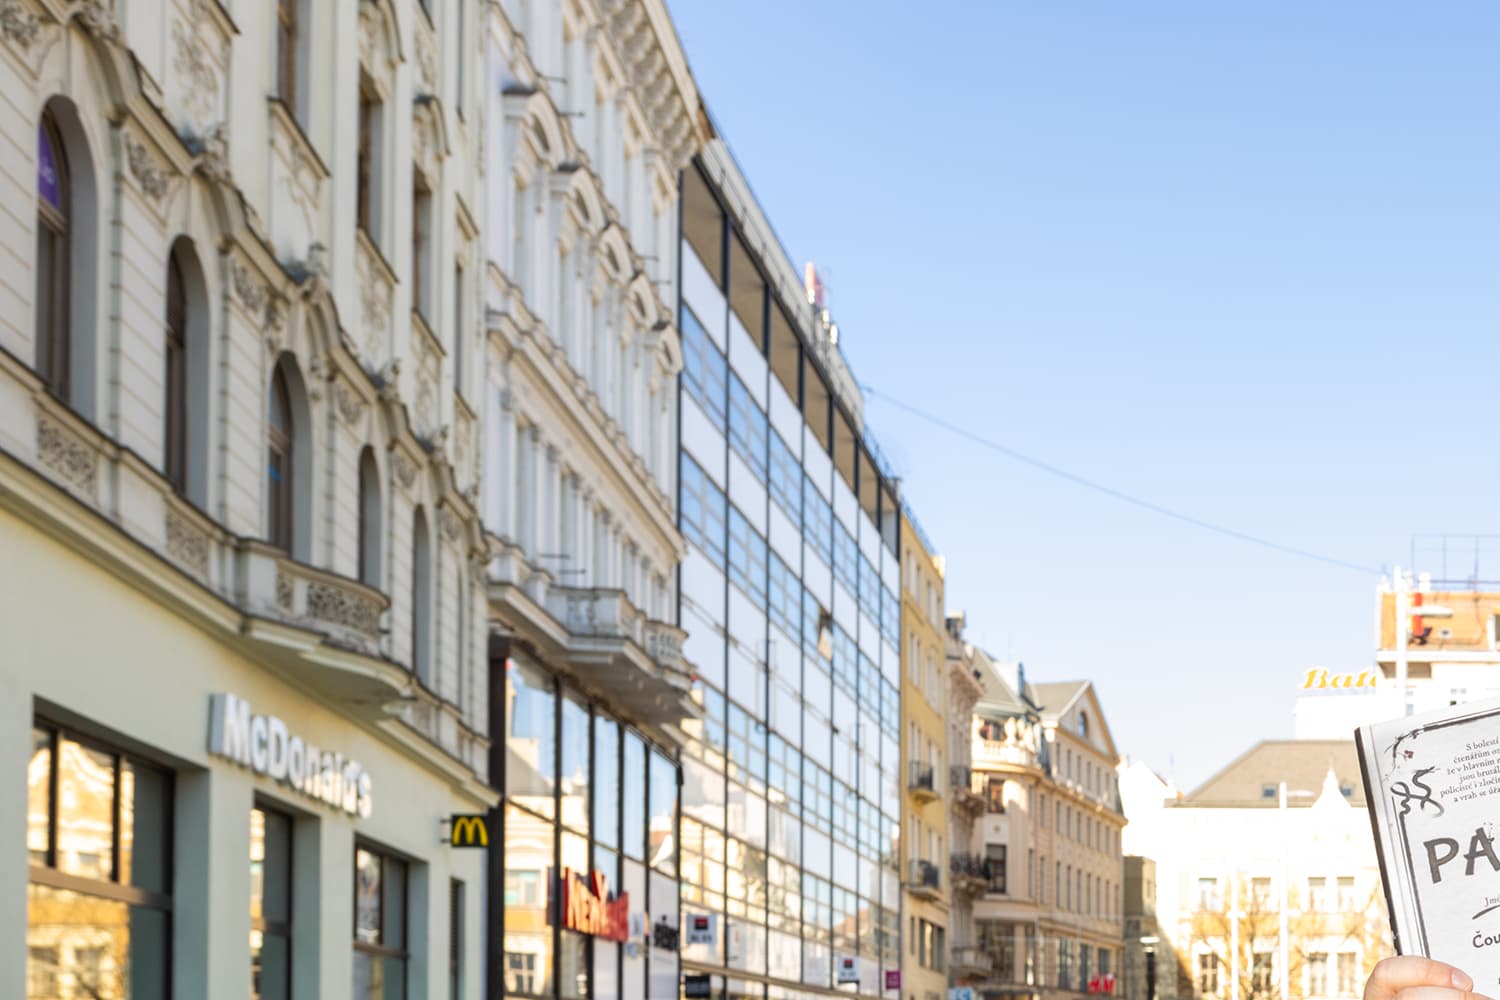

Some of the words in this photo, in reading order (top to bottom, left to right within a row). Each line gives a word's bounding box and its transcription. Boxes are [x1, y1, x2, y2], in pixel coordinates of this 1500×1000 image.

[211, 692, 373, 820] McDonald's
[1453, 750, 1491, 764] čtenářům
[1463, 758, 1495, 772] hlavním
[1440, 783, 1473, 798] policisté
[1460, 790, 1478, 802] vrah
